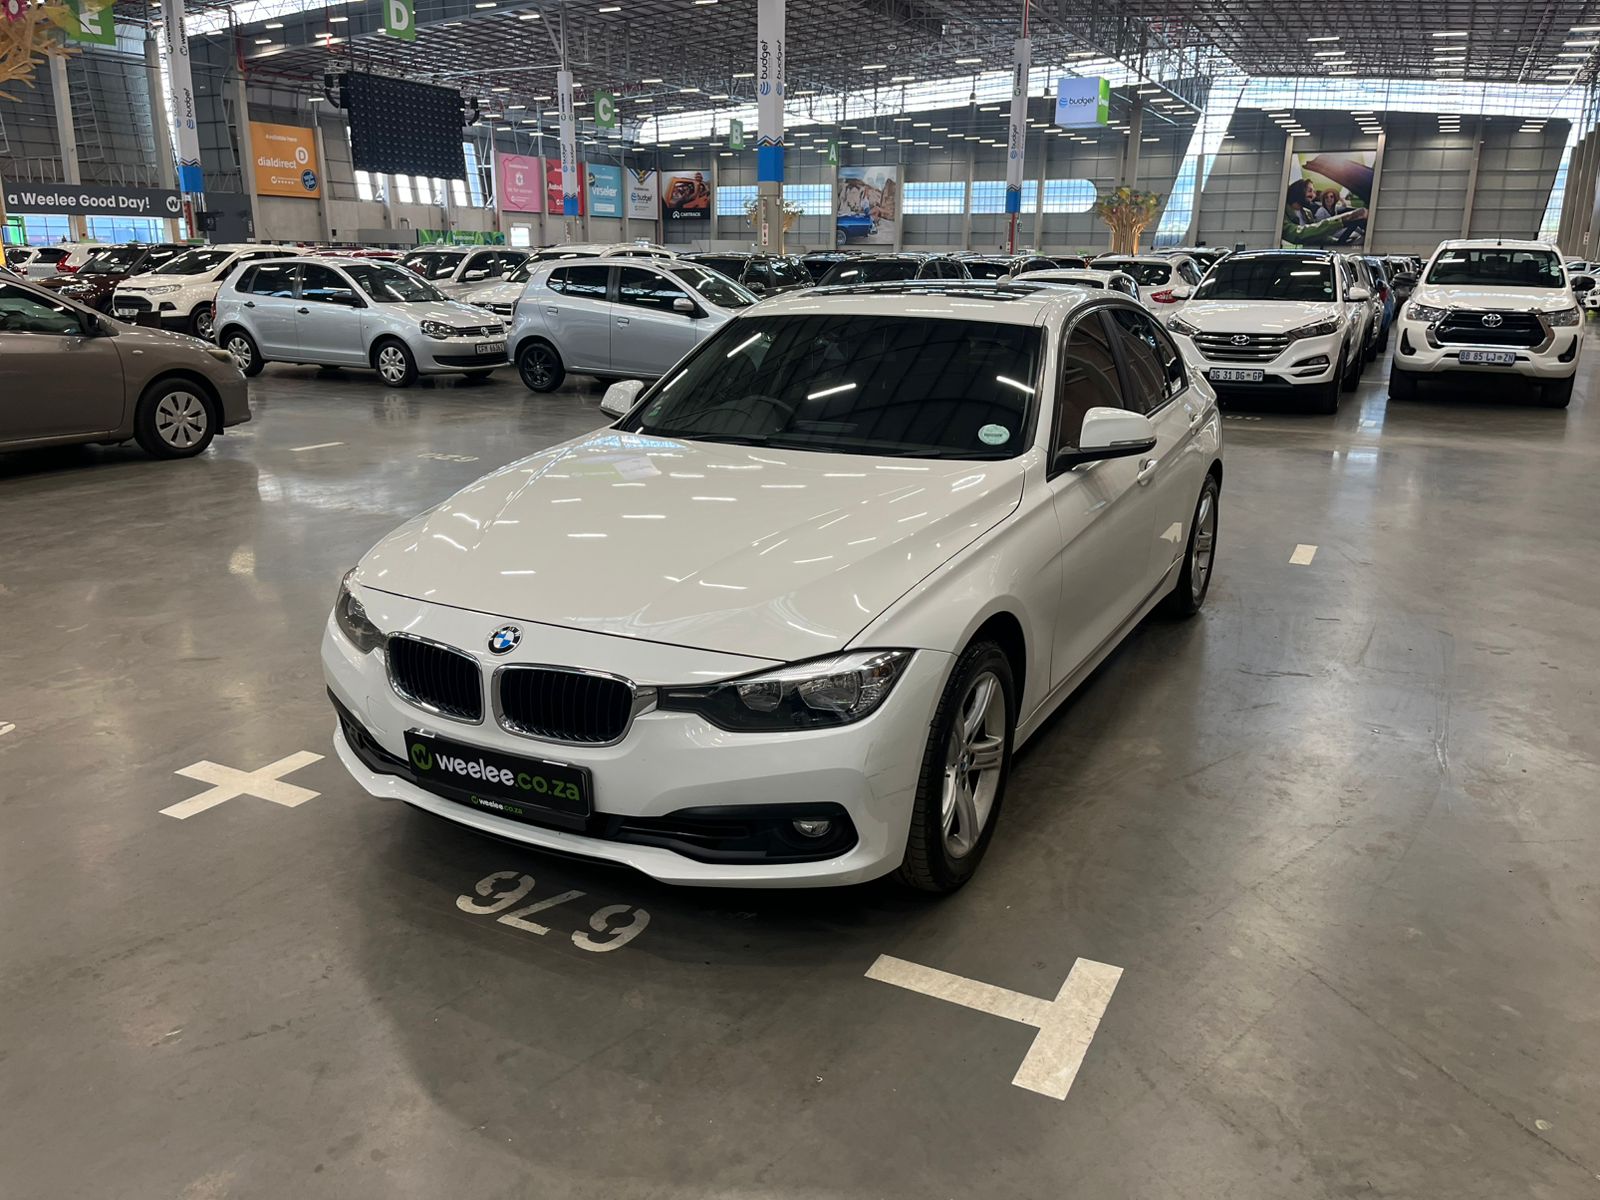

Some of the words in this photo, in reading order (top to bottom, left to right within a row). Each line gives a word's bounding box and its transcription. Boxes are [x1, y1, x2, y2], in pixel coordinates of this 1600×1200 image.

[390, 0, 409, 30] D
[760, 40, 771, 79] budget
[183, 88, 192, 118] budget
[1069, 96, 1095, 106] budget
[599, 98, 611, 122] C
[732, 127, 741, 144] B
[829, 144, 837, 161] A
[257, 156, 297, 169] dialdirect
[8, 194, 18, 205] a
[21, 192, 76, 206] Weelee
[79, 195, 116, 208] Good
[119, 196, 150, 212] Day!
[1473, 352, 1483, 360] 85
[1504, 354, 1513, 362] ZN
[1211, 370, 1220, 379] JG
[1223, 371, 1232, 380] 31
[1253, 372, 1262, 380] GP
[435, 753, 580, 800] weelee.co.za
[479, 798, 523, 814] weelee.co.za
